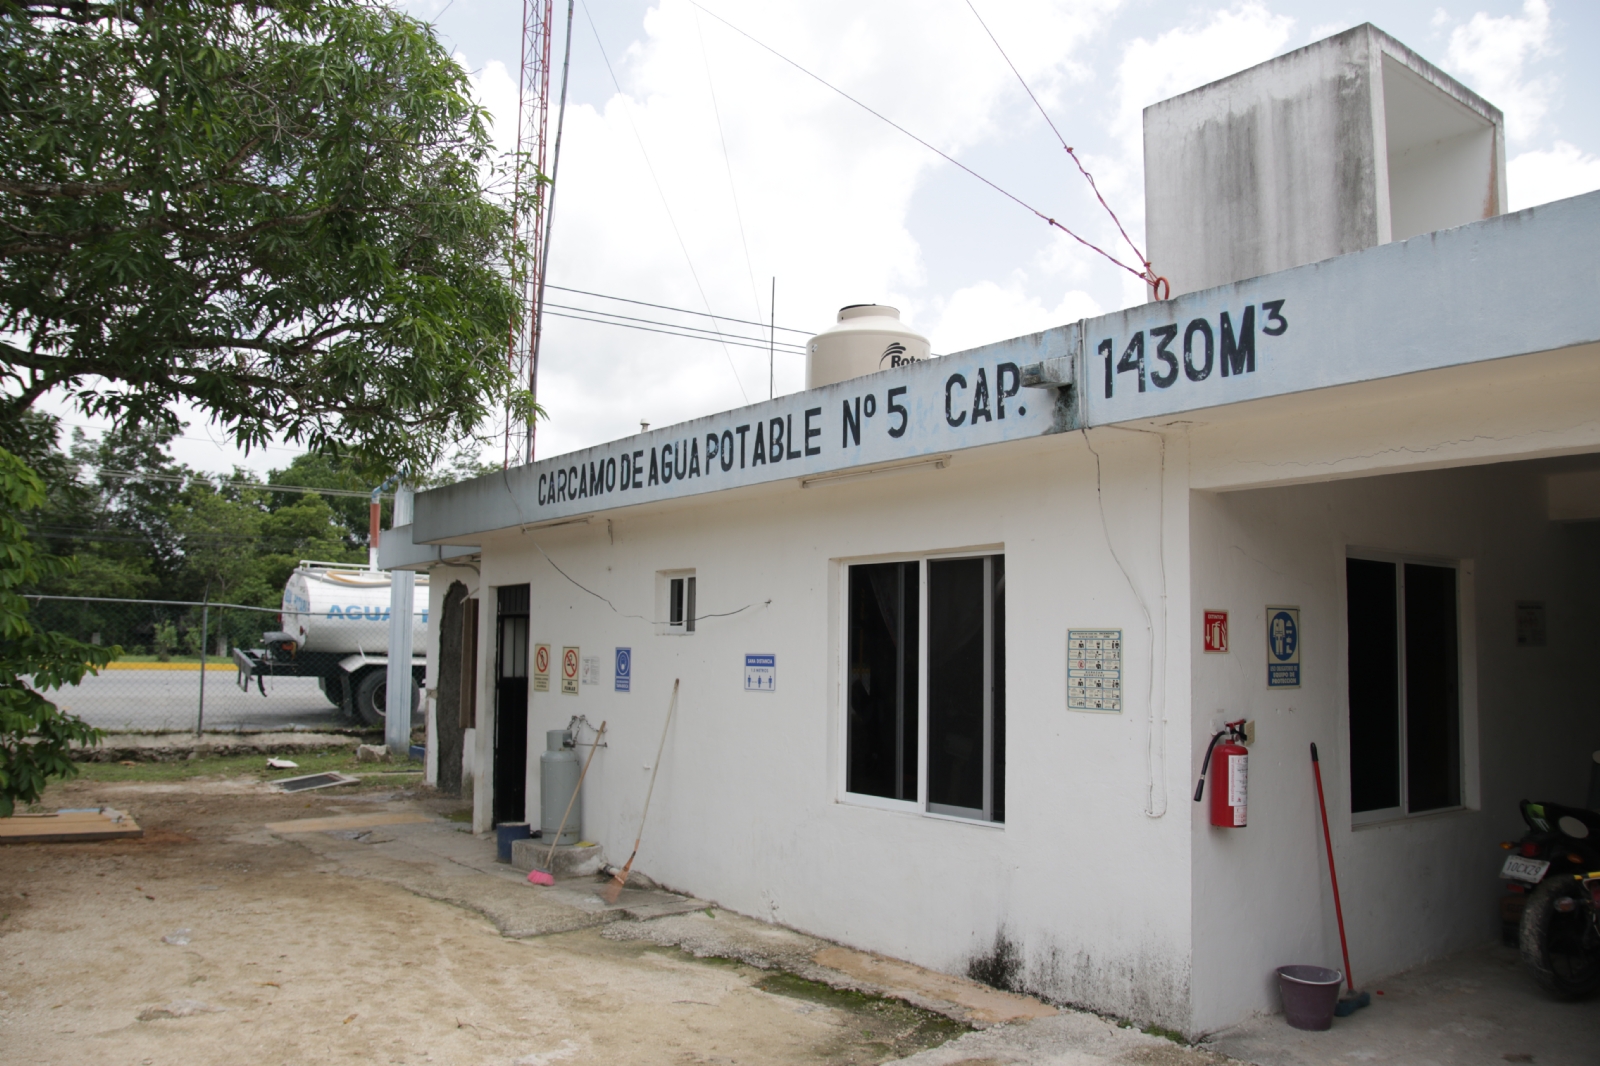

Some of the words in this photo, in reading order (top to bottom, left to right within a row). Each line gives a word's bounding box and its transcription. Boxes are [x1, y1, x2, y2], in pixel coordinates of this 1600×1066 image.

[538, 457, 616, 506] CARCAMO
[620, 450, 643, 491] DE
[648, 437, 700, 487] AGUA
[706, 407, 822, 475] POTABLE
[887, 386, 908, 438] 5
[945, 361, 1027, 428] CAP.
